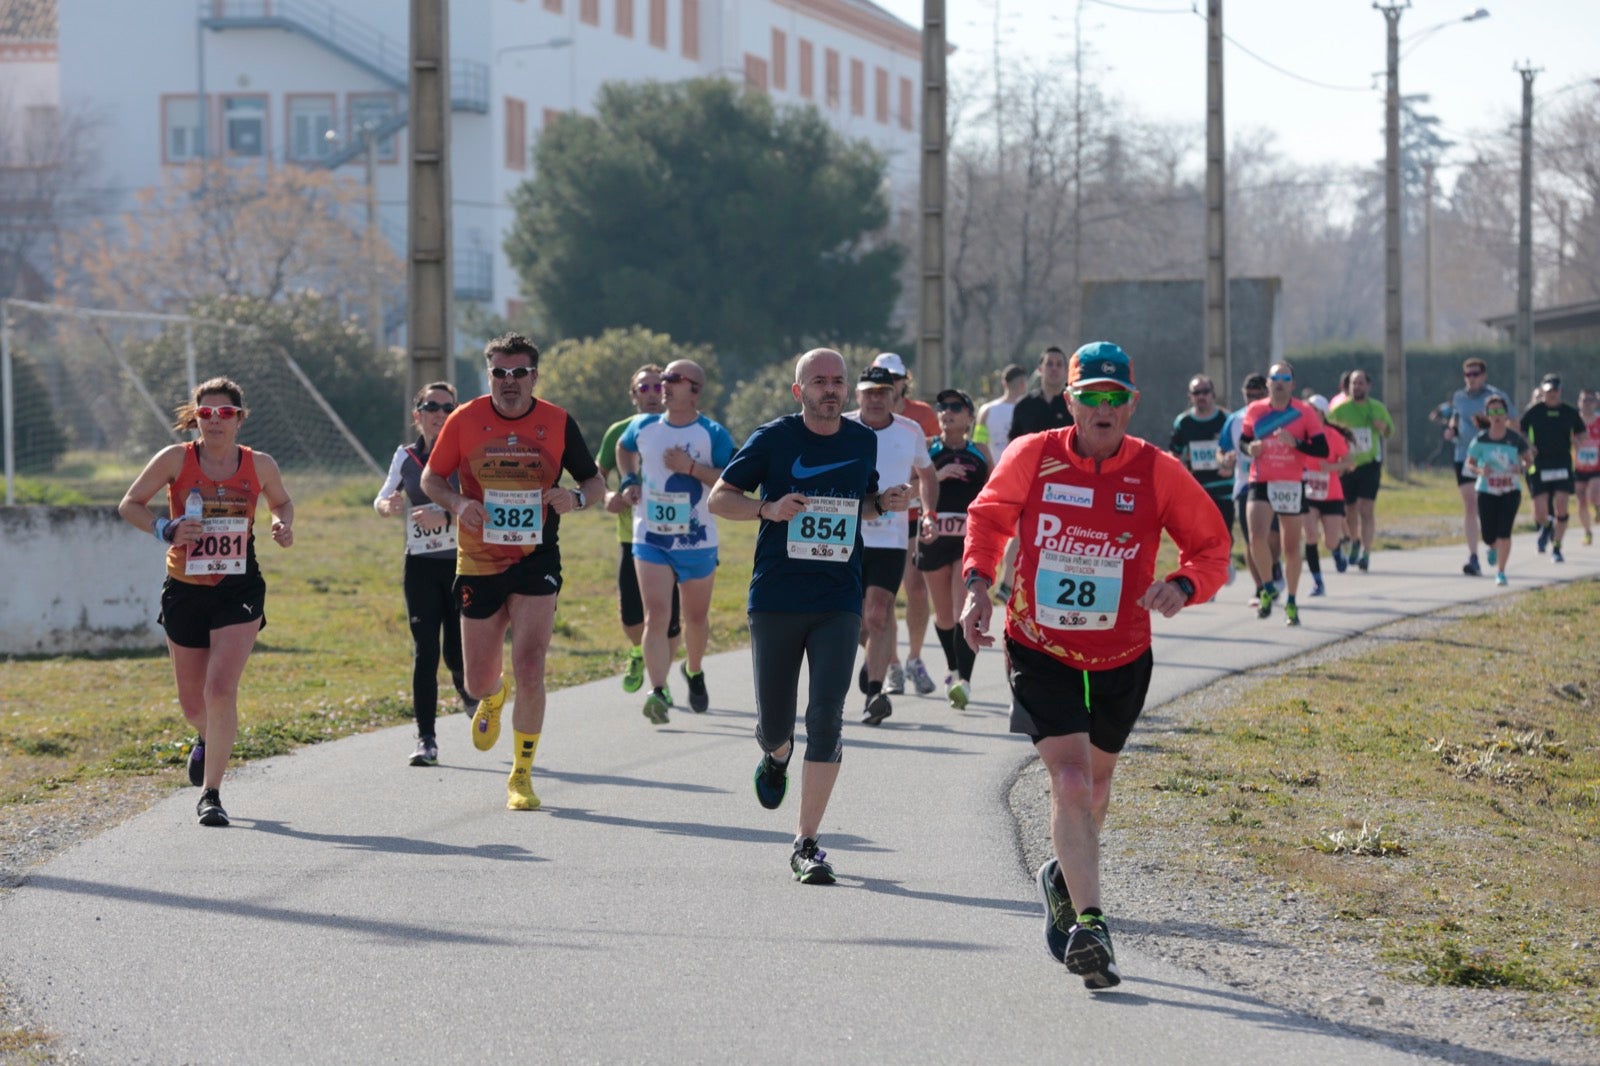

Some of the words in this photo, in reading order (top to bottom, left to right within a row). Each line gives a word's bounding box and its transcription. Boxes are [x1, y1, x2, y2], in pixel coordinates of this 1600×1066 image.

[493, 507, 534, 528] 382
[655, 505, 676, 521] 30
[800, 515, 846, 541] 854
[1033, 512, 1141, 560] Polisalud
[1065, 525, 1110, 541] Clínicas
[190, 535, 242, 558] 2081
[1056, 578, 1096, 607] 28
